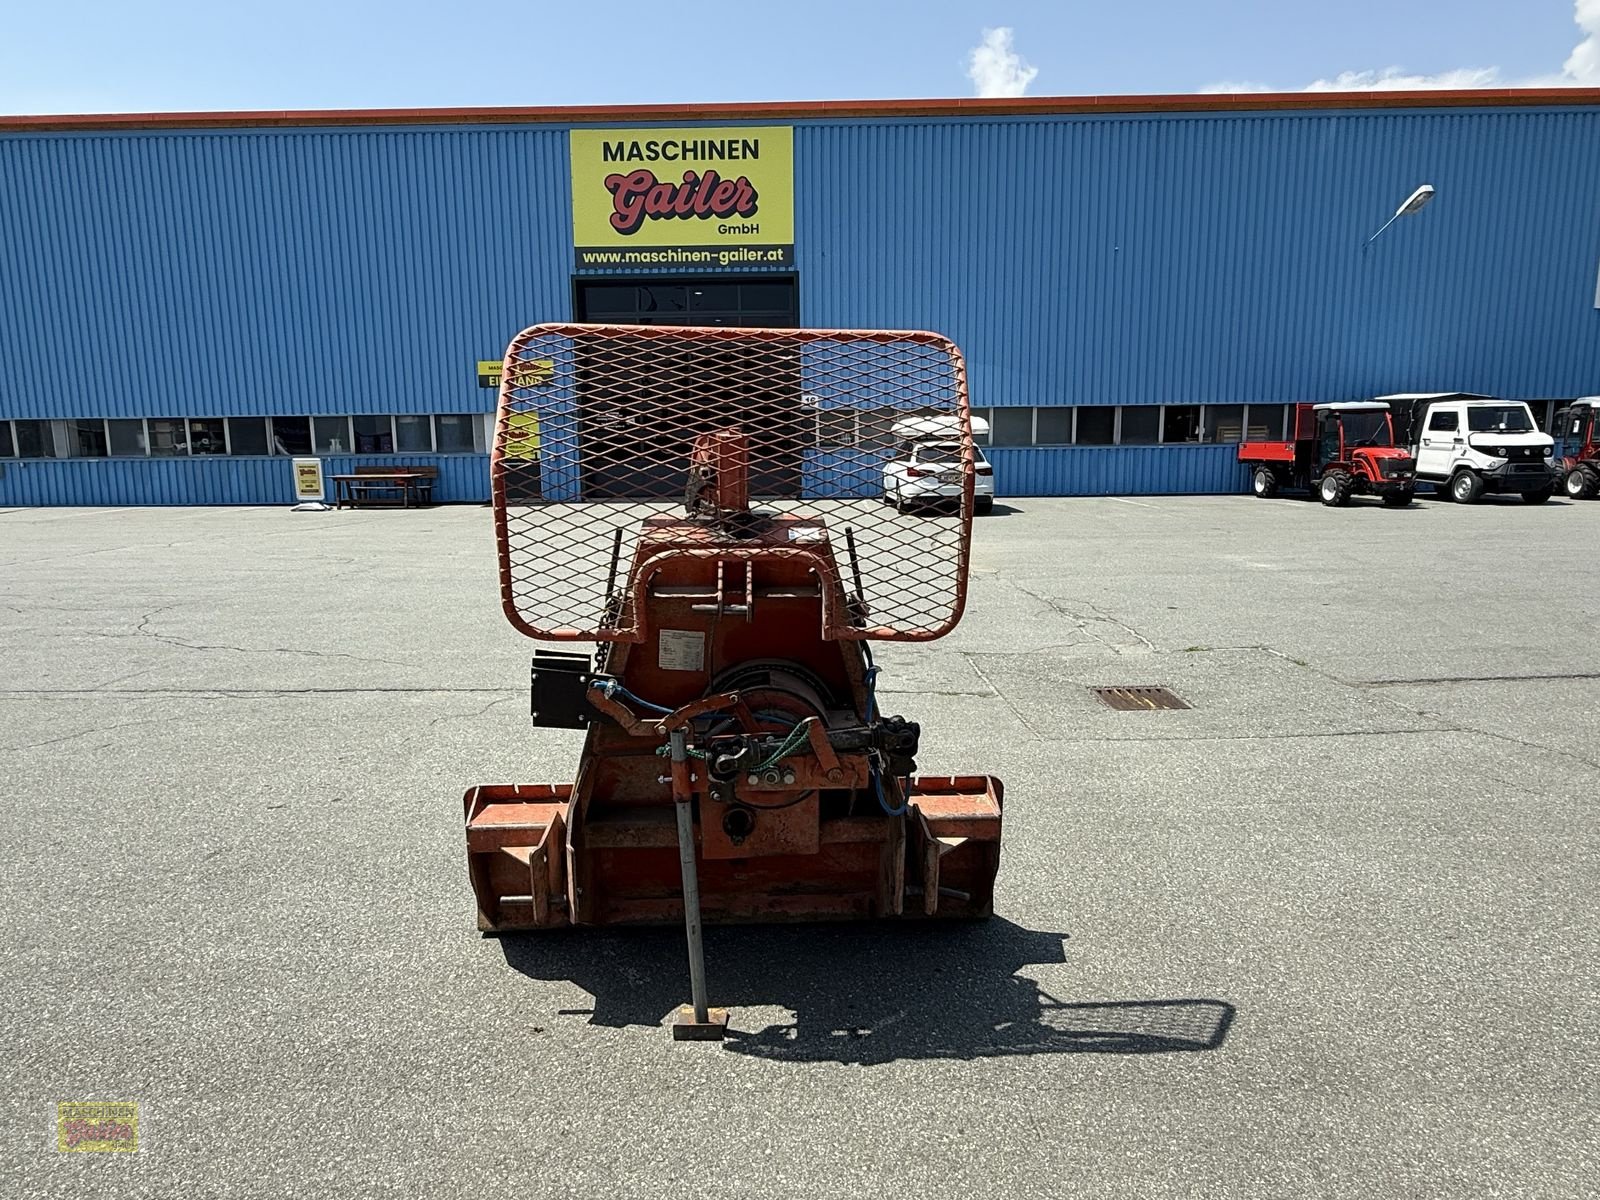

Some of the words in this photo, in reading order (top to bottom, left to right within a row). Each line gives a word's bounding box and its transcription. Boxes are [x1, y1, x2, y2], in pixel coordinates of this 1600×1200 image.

[602, 139, 760, 162] MASCHINEN
[604, 168, 759, 236] Gailer
[717, 224, 760, 235] GmbH
[582, 248, 784, 266] www.maschinen-gailer.at
